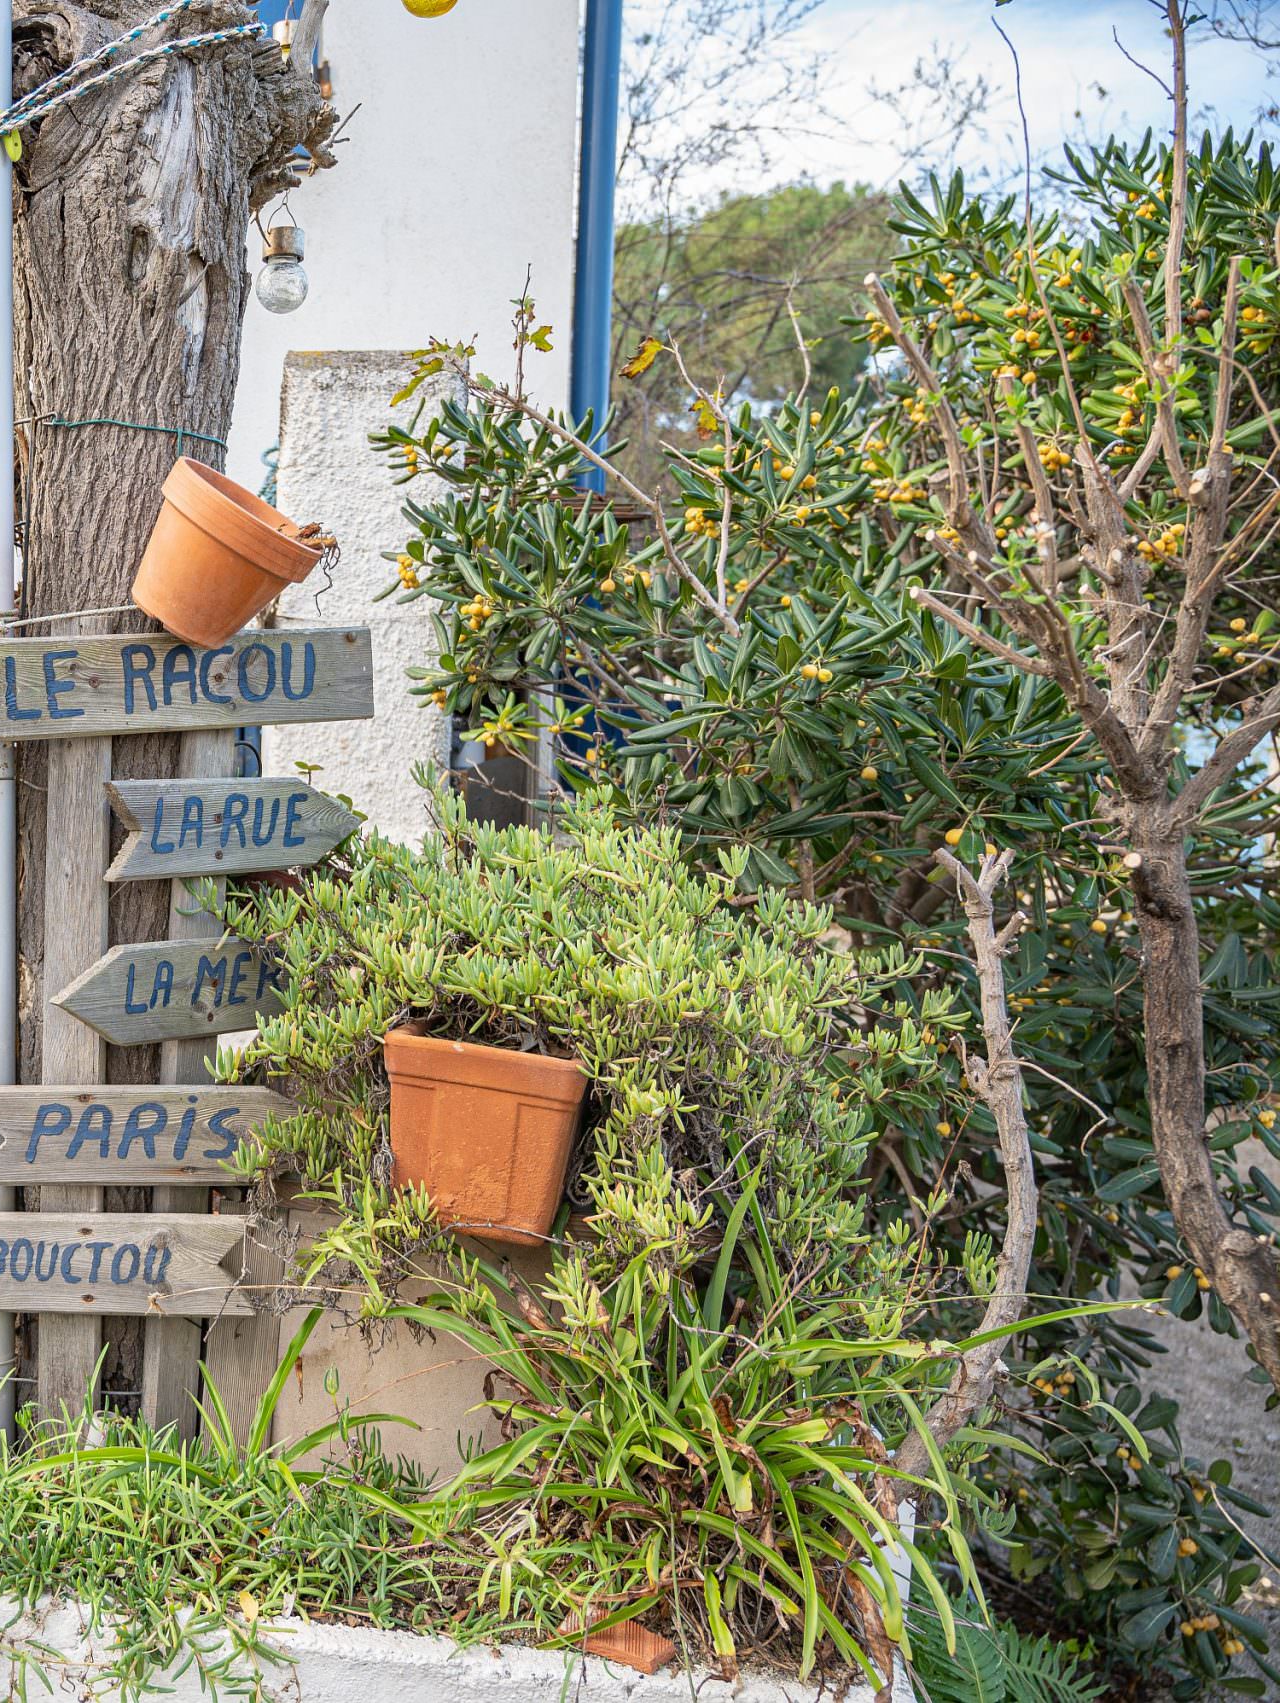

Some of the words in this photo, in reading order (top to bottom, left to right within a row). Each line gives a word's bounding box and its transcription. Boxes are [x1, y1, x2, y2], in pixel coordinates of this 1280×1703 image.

[4, 649, 85, 721] LE
[121, 641, 316, 715] RACOU
[151, 796, 203, 854] LA
[220, 792, 308, 848] RUE
[124, 959, 174, 1015] LA
